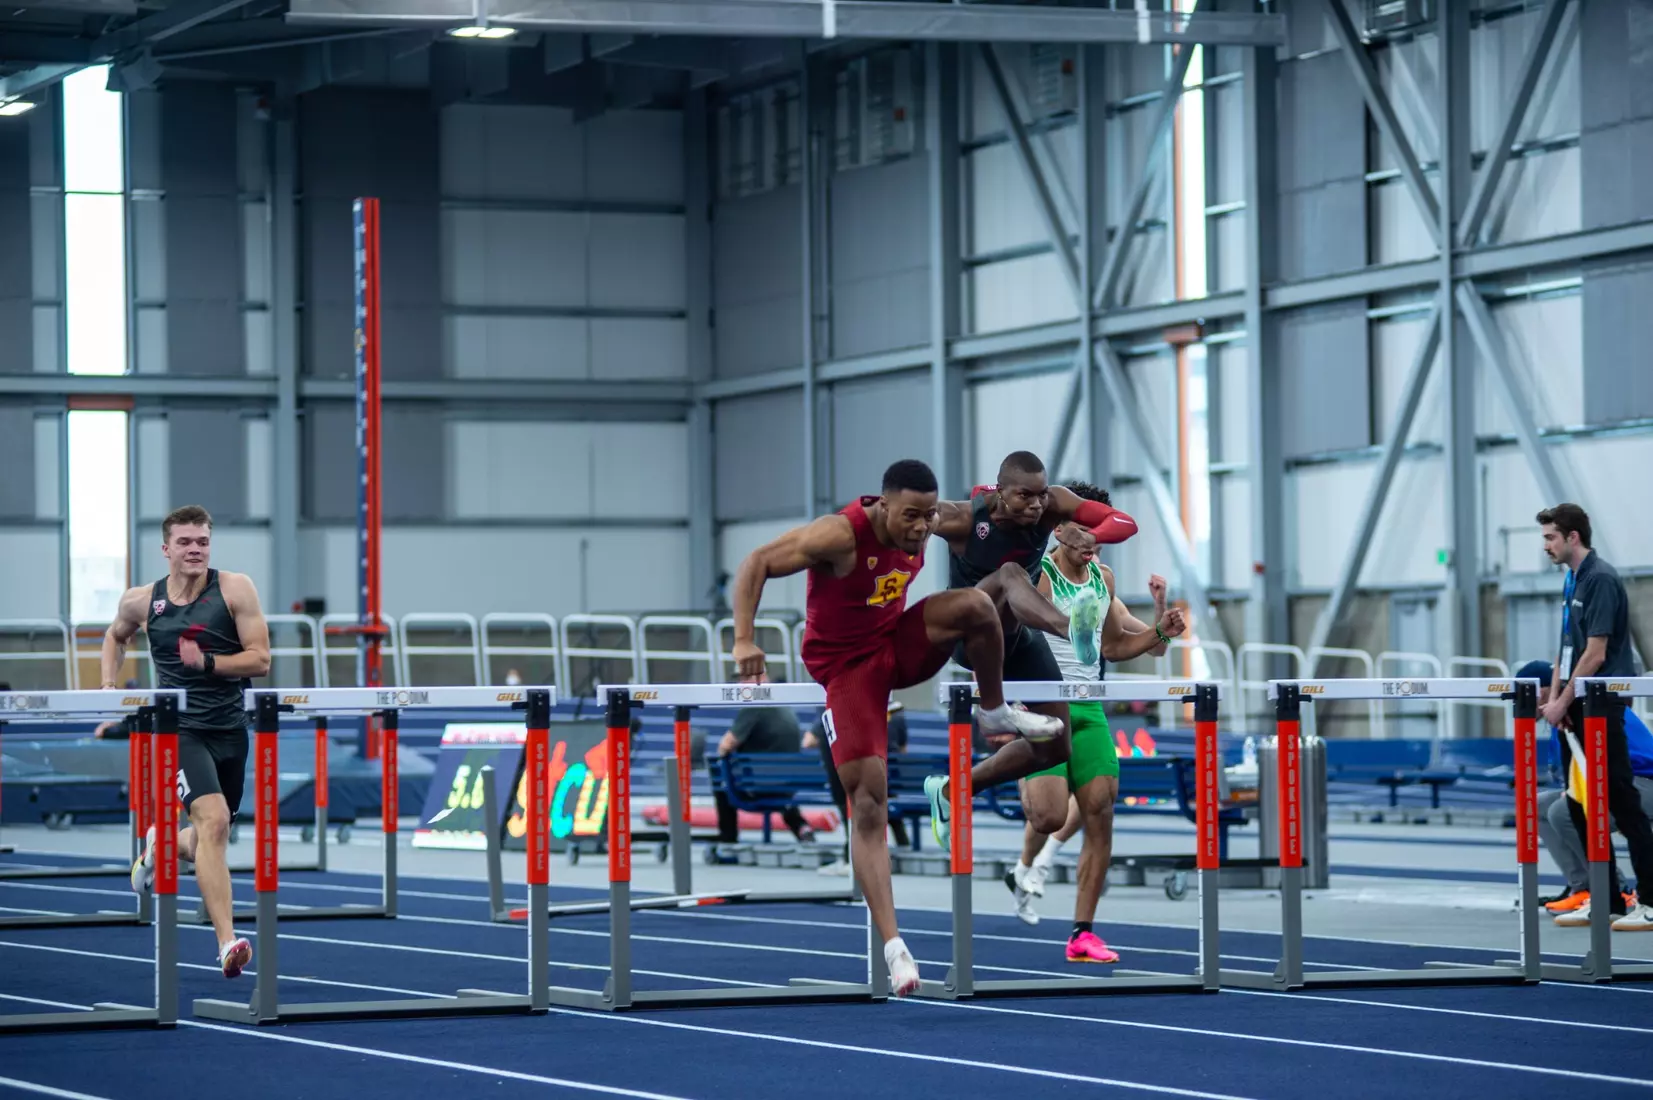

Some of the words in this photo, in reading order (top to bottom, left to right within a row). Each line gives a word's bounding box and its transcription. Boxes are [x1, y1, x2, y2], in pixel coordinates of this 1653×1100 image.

[1058, 684, 1070, 697] THE
[1073, 683, 1106, 699] PODIUM
[1167, 686, 1192, 695] GILL
[1301, 685, 1325, 694] GILL
[1382, 682, 1394, 695] THE
[1396, 681, 1429, 696] PODIUM
[1487, 683, 1511, 692] GILL
[1608, 682, 1632, 691] GILL
[121, 696, 150, 706] GILL
[282, 695, 311, 704] GILL
[376, 691, 390, 705] THE
[392, 690, 430, 706] PODIUM
[496, 692, 523, 702] GILL
[632, 690, 659, 700] GILL
[721, 688, 734, 701] THE
[736, 687, 772, 702] PODIUM
[1205, 735, 1214, 857] SPOKANE
[1287, 734, 1297, 855] SPOKANE
[1524, 732, 1534, 851] SPOKANE
[1594, 730, 1605, 849] SPOKANE
[263, 747, 273, 878] SPOKANE
[536, 743, 545, 871] SPOKANE
[616, 741, 626, 869] SPOKANE
[163, 748, 173, 880] SPOKANE
